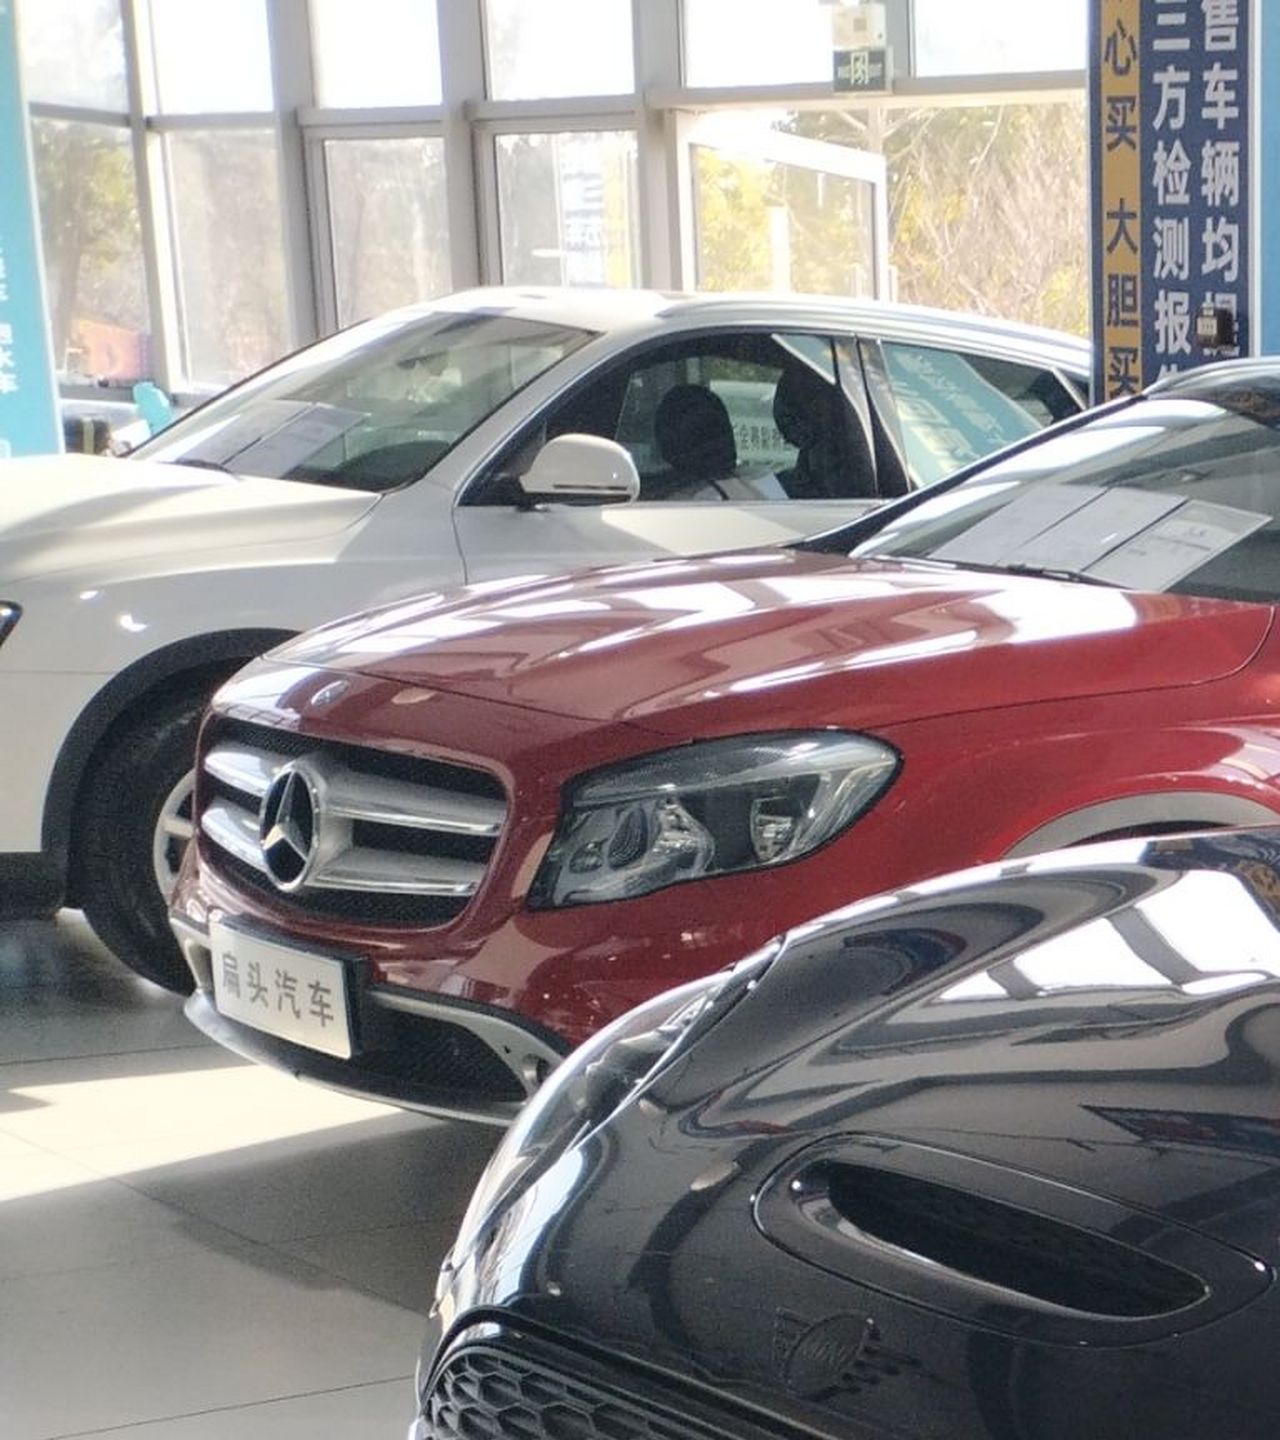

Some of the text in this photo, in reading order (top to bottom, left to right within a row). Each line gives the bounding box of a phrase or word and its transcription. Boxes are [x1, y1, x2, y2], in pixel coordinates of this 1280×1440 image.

[1152, 0, 1192, 380] 三方检测报
